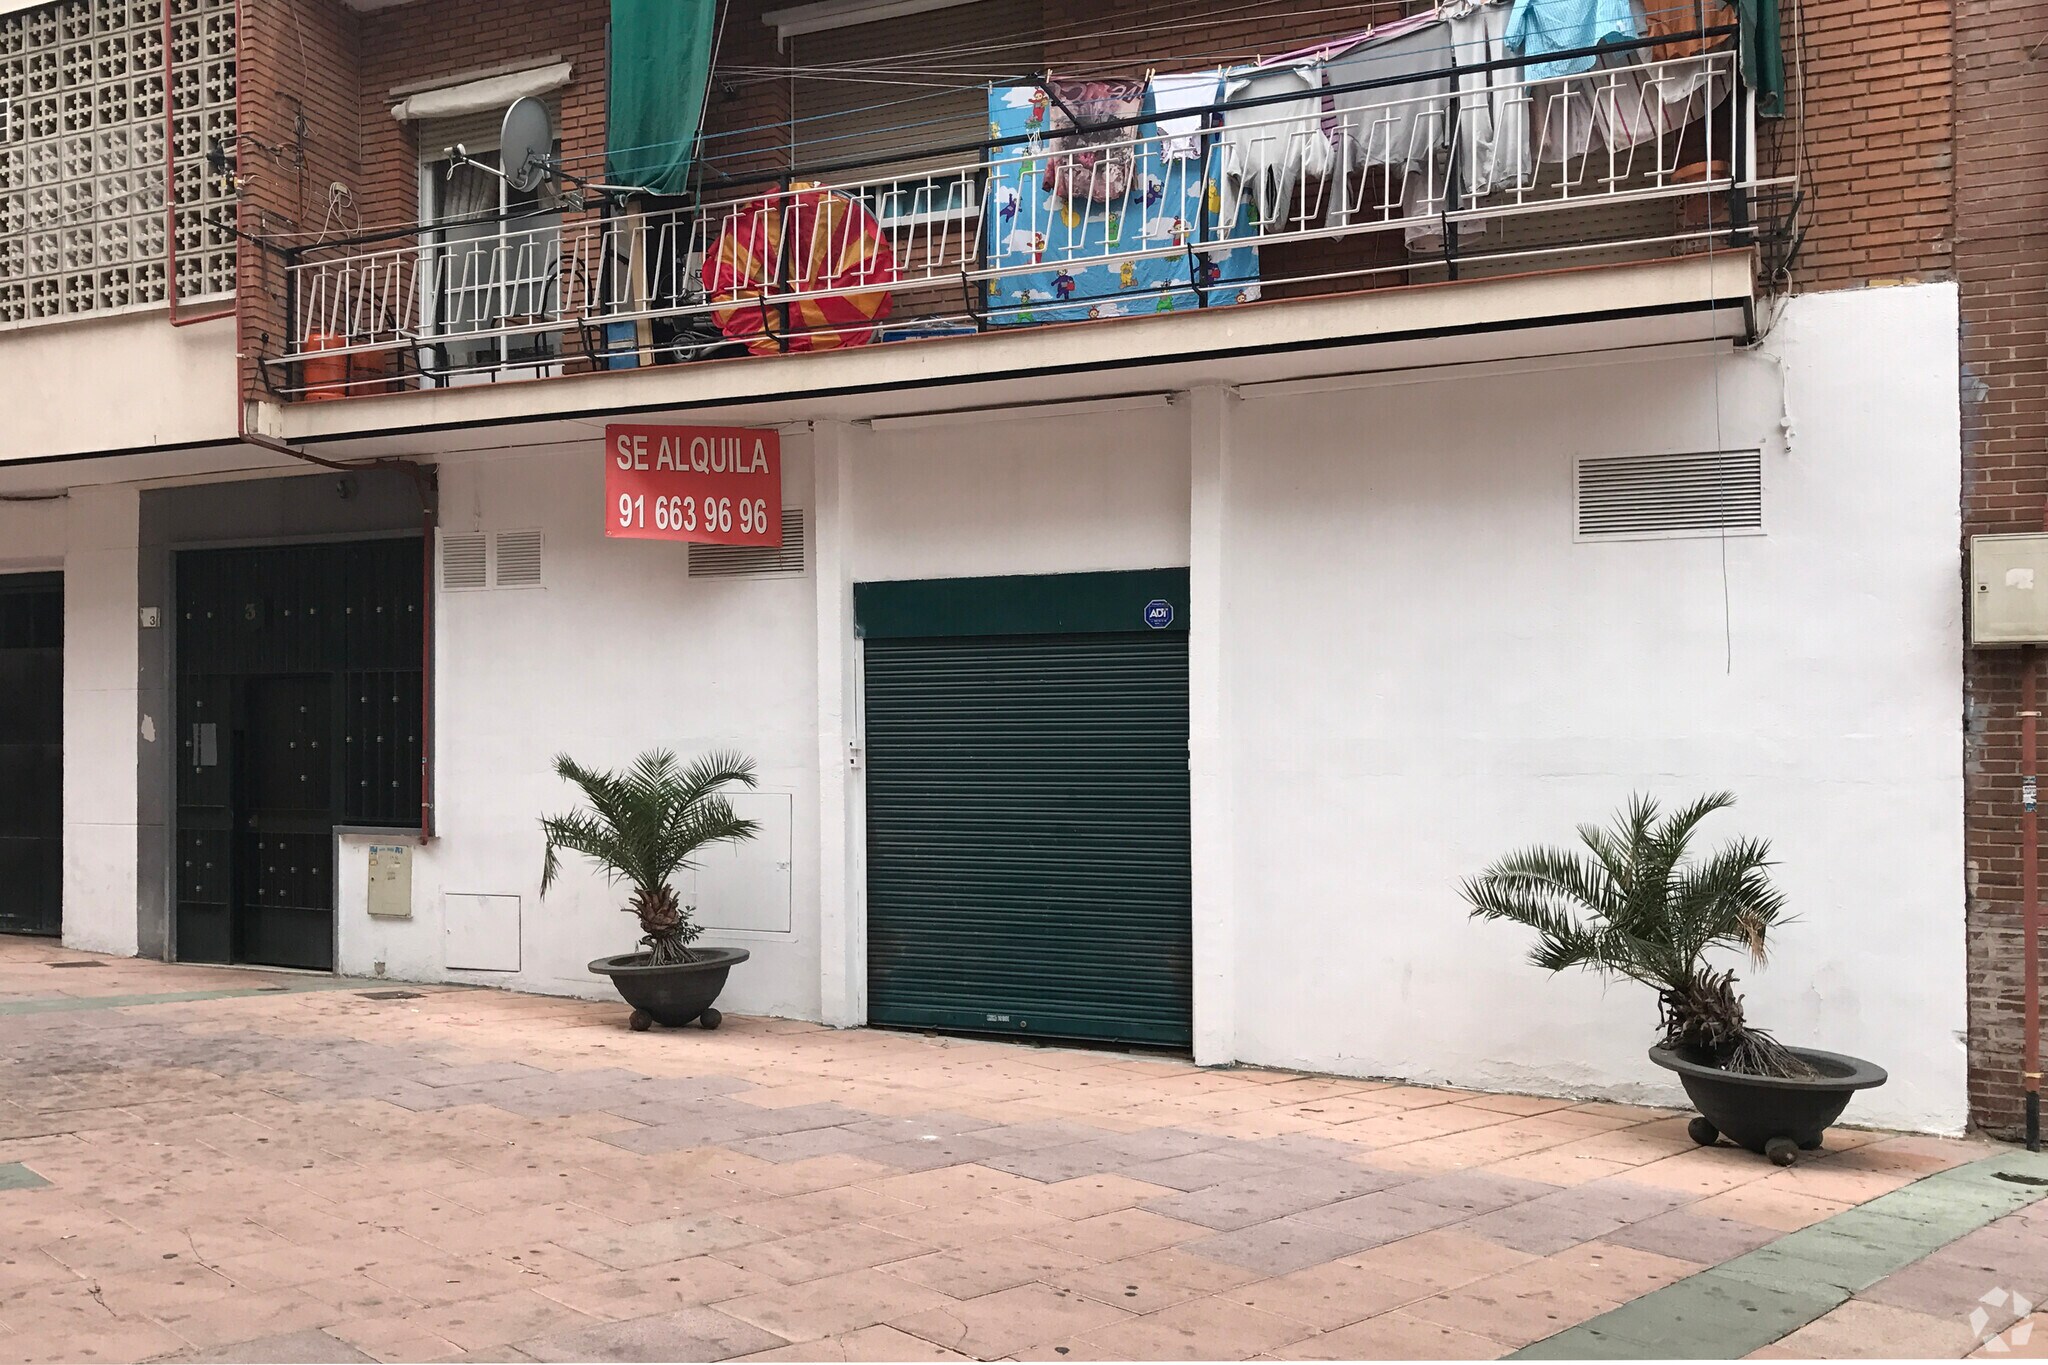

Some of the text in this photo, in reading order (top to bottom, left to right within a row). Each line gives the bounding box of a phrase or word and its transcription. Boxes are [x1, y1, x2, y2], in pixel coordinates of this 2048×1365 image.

[616, 434, 769, 474] SE ALQUILA
[618, 493, 768, 534] 91 663 96 96
[149, 616, 155, 625] 3
[1149, 608, 1168, 618] ADT
